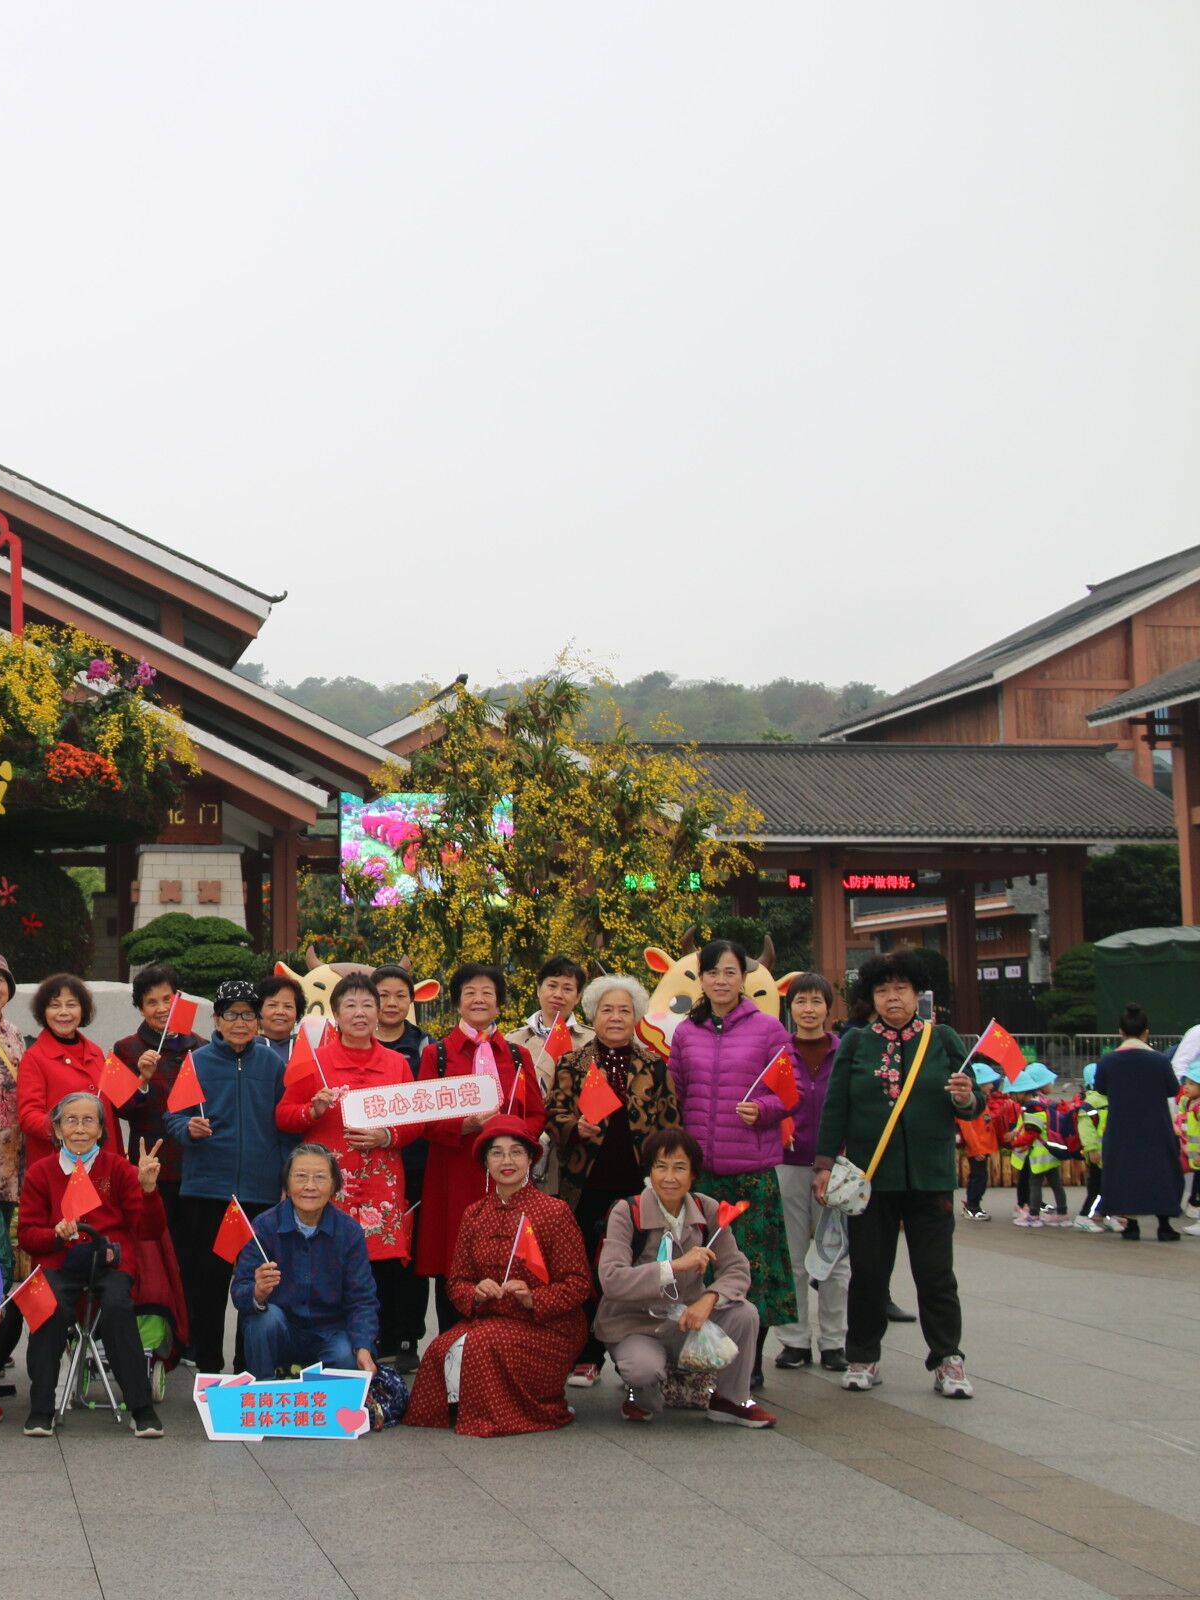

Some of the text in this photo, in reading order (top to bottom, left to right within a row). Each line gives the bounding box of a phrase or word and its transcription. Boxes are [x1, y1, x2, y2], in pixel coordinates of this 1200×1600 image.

[363, 1082, 481, 1119] 我心永向党
[240, 1391, 327, 1409] 离岗不离党
[240, 1410, 327, 1428] 退休不褪色
